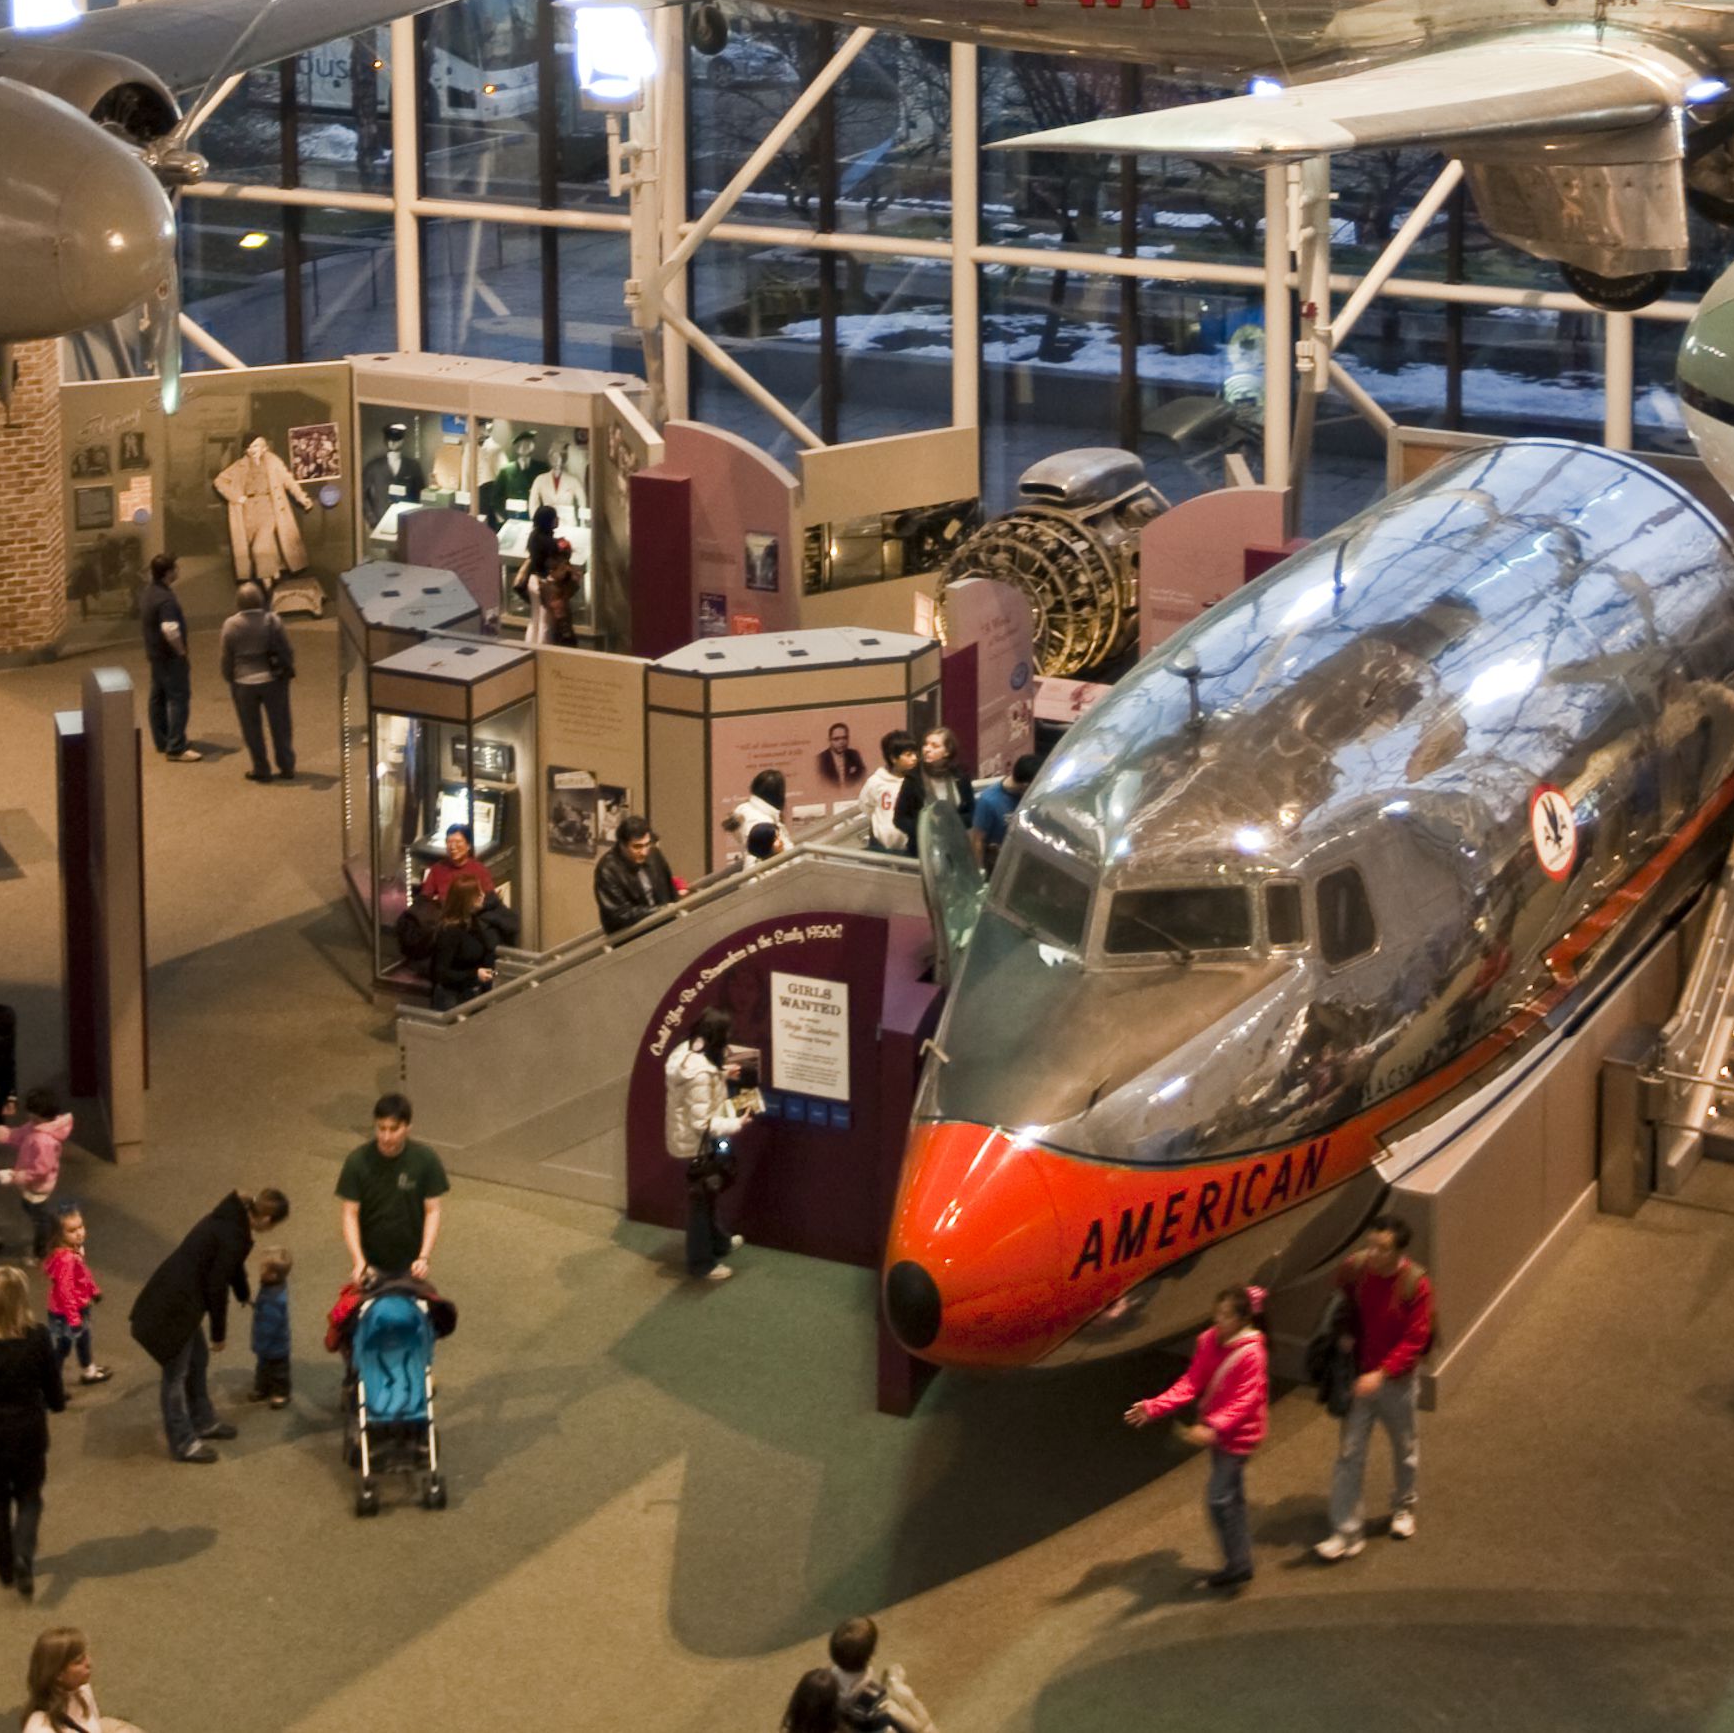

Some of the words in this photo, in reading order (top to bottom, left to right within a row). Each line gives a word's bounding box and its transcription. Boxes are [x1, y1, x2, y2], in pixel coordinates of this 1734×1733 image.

[757, 934, 773, 950] the
[787, 982, 833, 1001] GIRLS
[779, 995, 842, 1017] WANTED
[1069, 1138, 1331, 1282] AMERICAN
